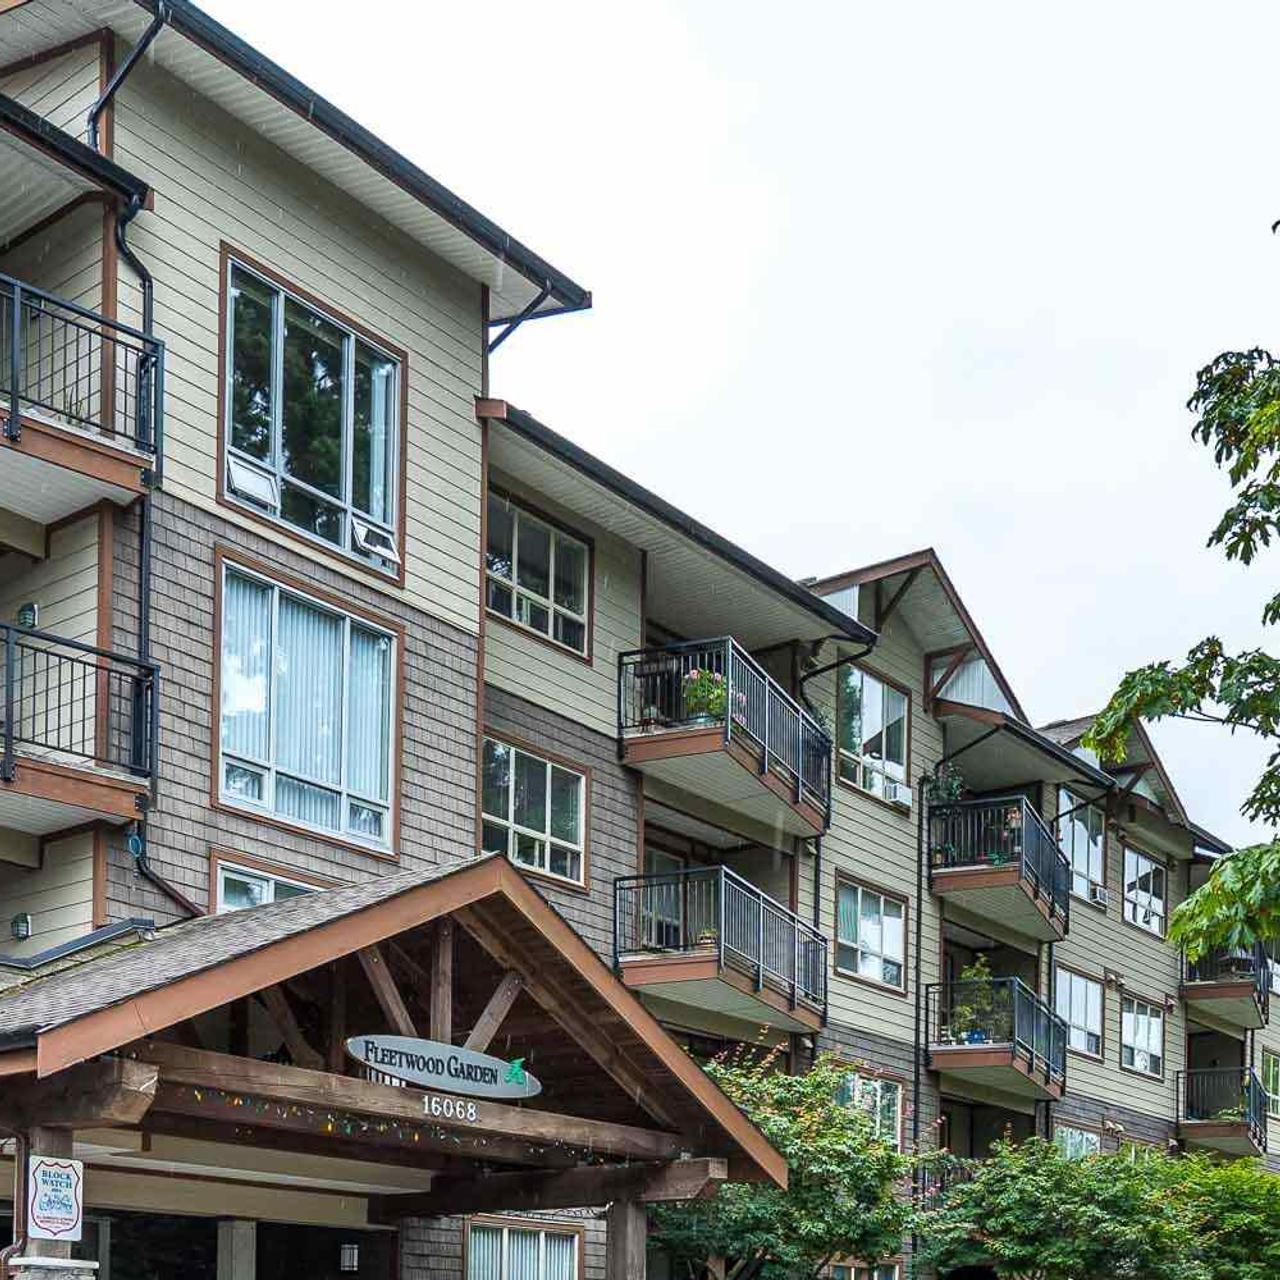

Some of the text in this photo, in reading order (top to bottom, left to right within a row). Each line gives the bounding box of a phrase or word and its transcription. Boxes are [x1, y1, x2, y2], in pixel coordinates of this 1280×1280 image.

[363, 1040, 498, 1085] FLEETWOOD GARDEN
[422, 1095, 477, 1121] 16068
[41, 1170, 71, 1180] BLOCK
[41, 1178, 72, 1189] WATCH
